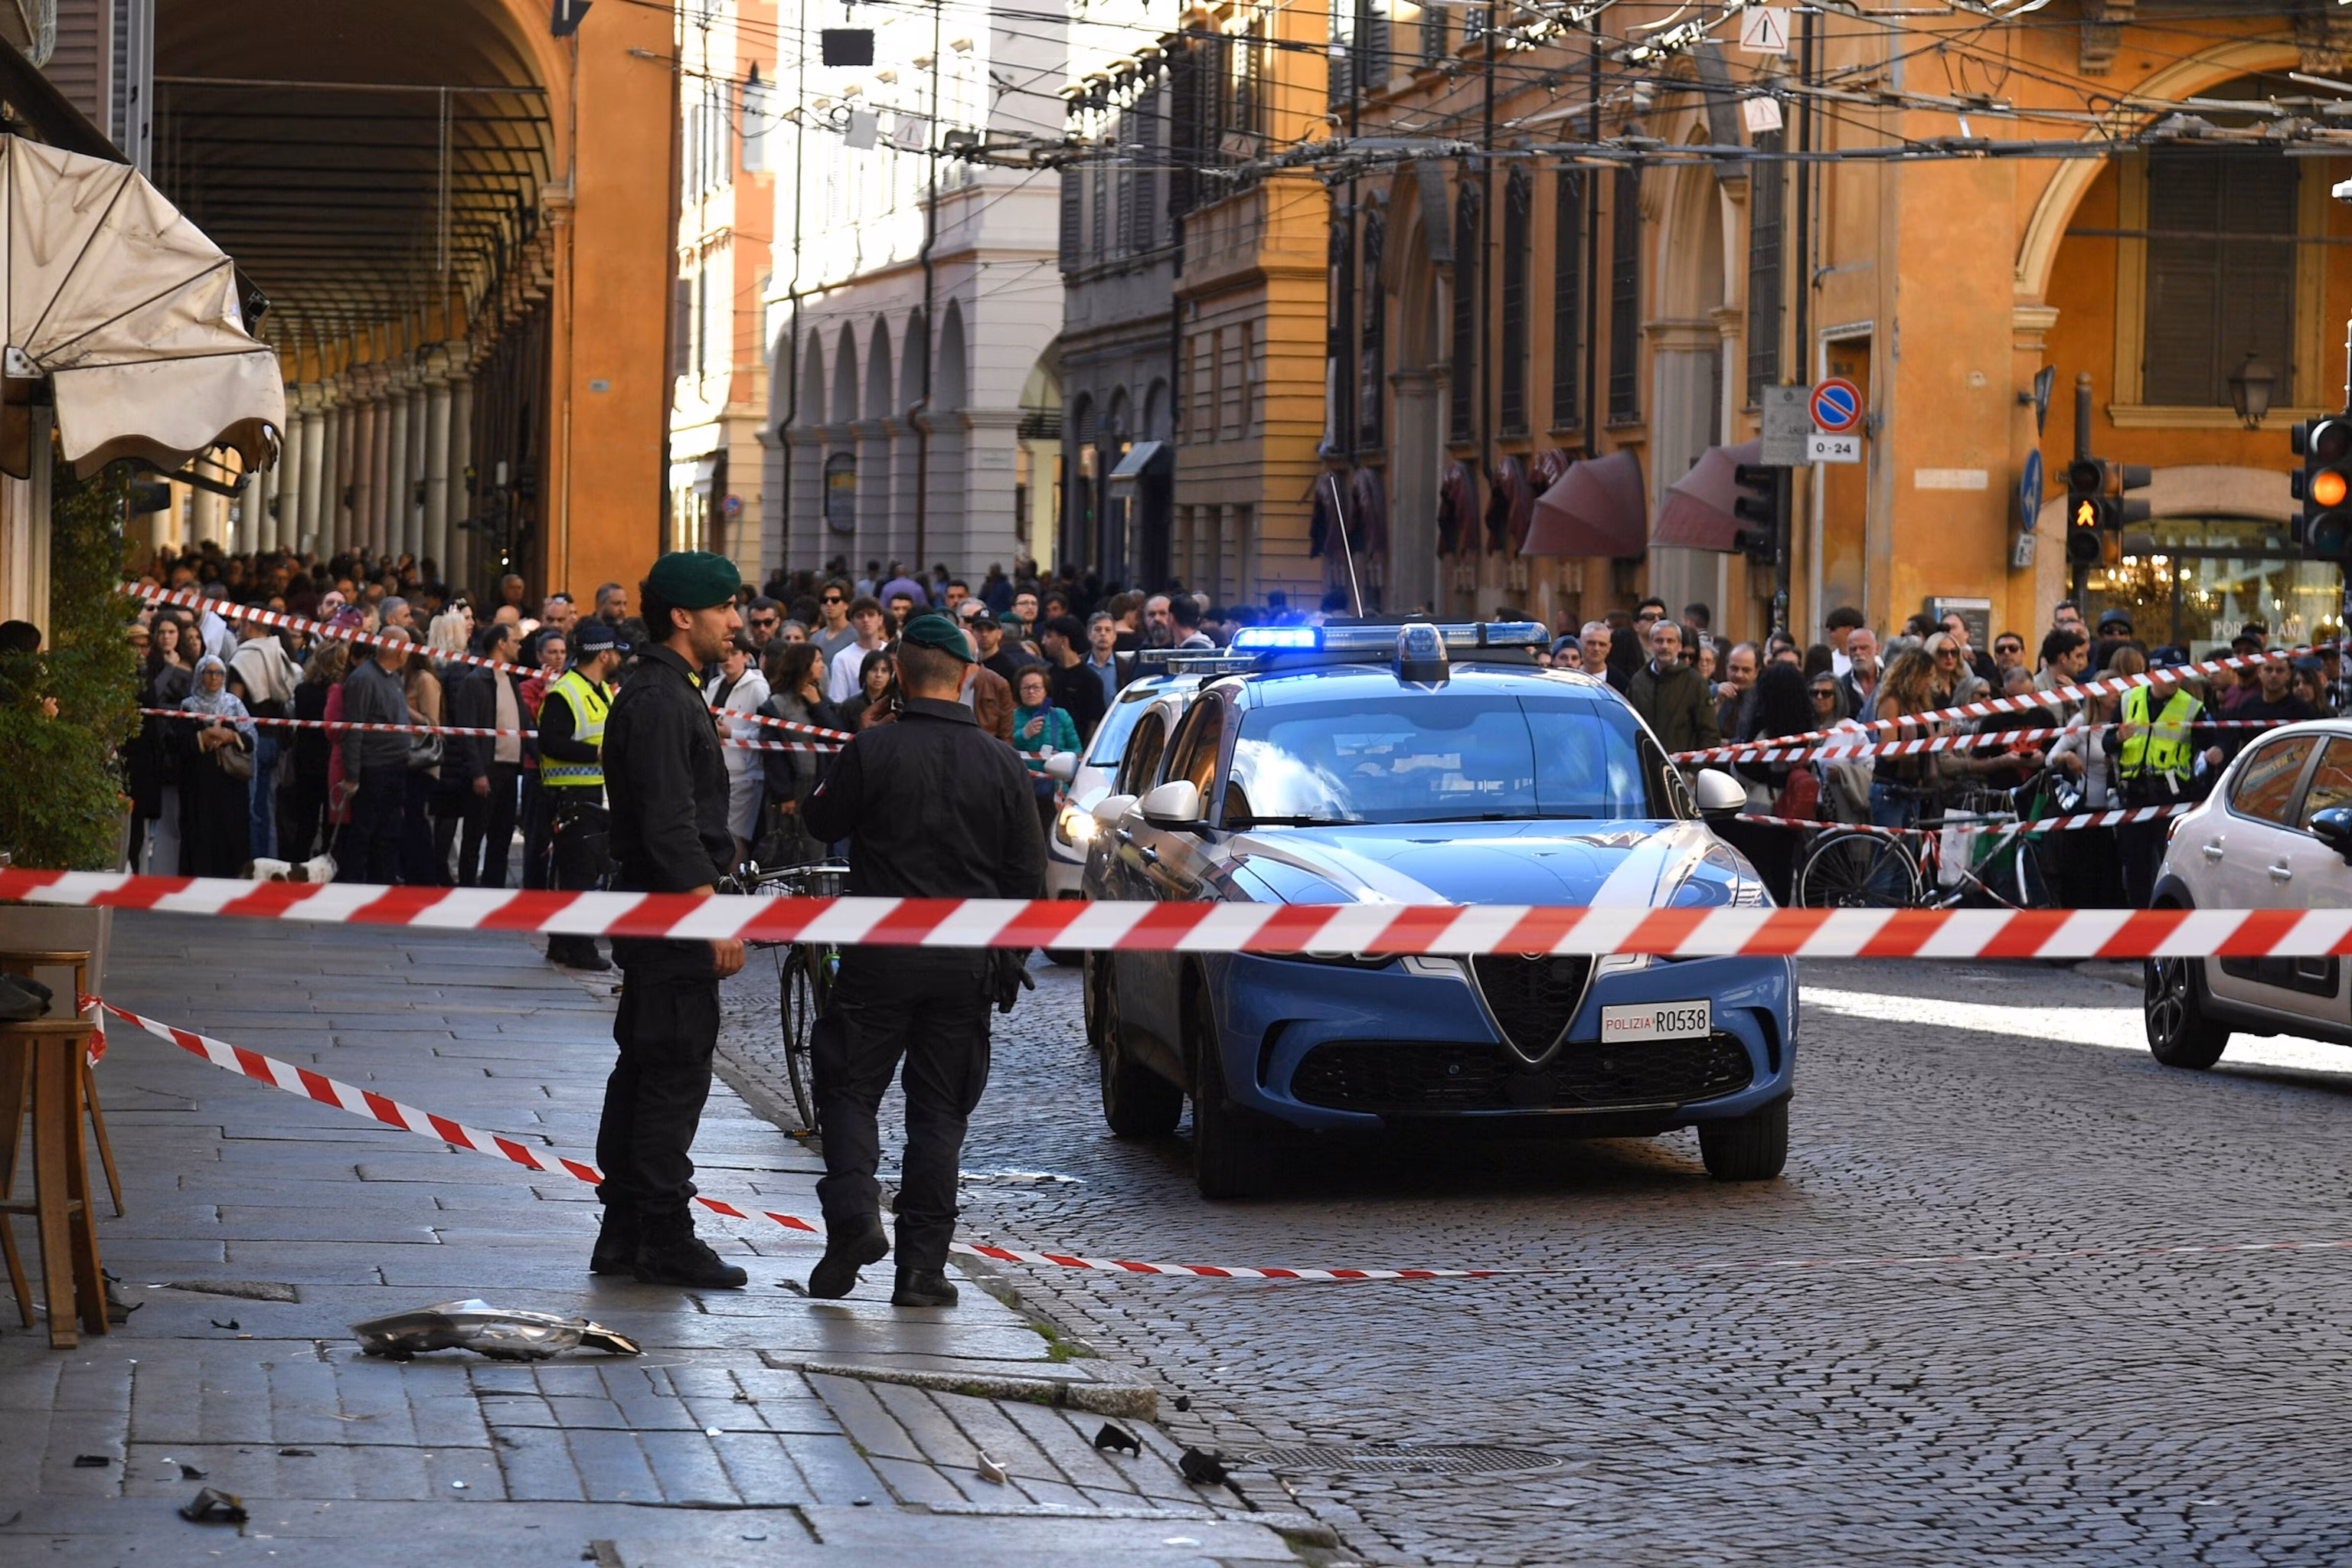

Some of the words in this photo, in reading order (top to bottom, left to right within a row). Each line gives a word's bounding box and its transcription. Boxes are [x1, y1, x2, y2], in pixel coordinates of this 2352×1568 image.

[1816, 442, 1825, 453] 0
[1834, 443, 1851, 453] 24
[2212, 619, 2308, 637] PORLANA
[1606, 1018, 1651, 1031] POLIZIA
